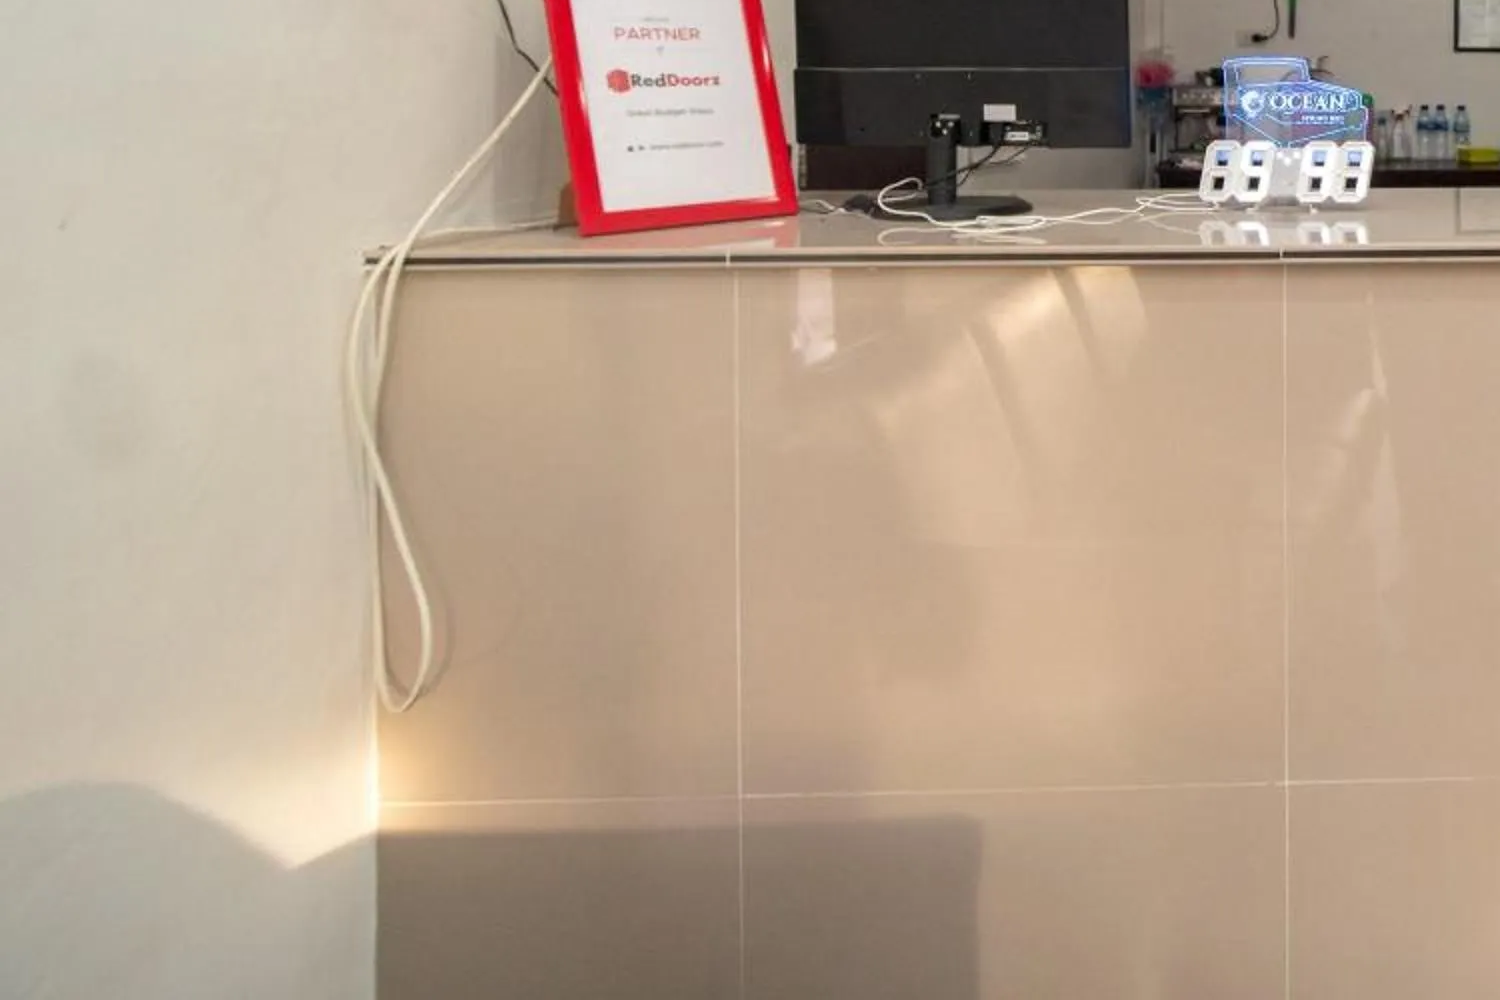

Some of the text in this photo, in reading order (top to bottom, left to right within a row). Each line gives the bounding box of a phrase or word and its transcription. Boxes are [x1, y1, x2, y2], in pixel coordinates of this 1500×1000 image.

[614, 26, 701, 42] PARTNER
[631, 72, 720, 89] RedDoorz
[1269, 91, 1345, 111] OCEAN
